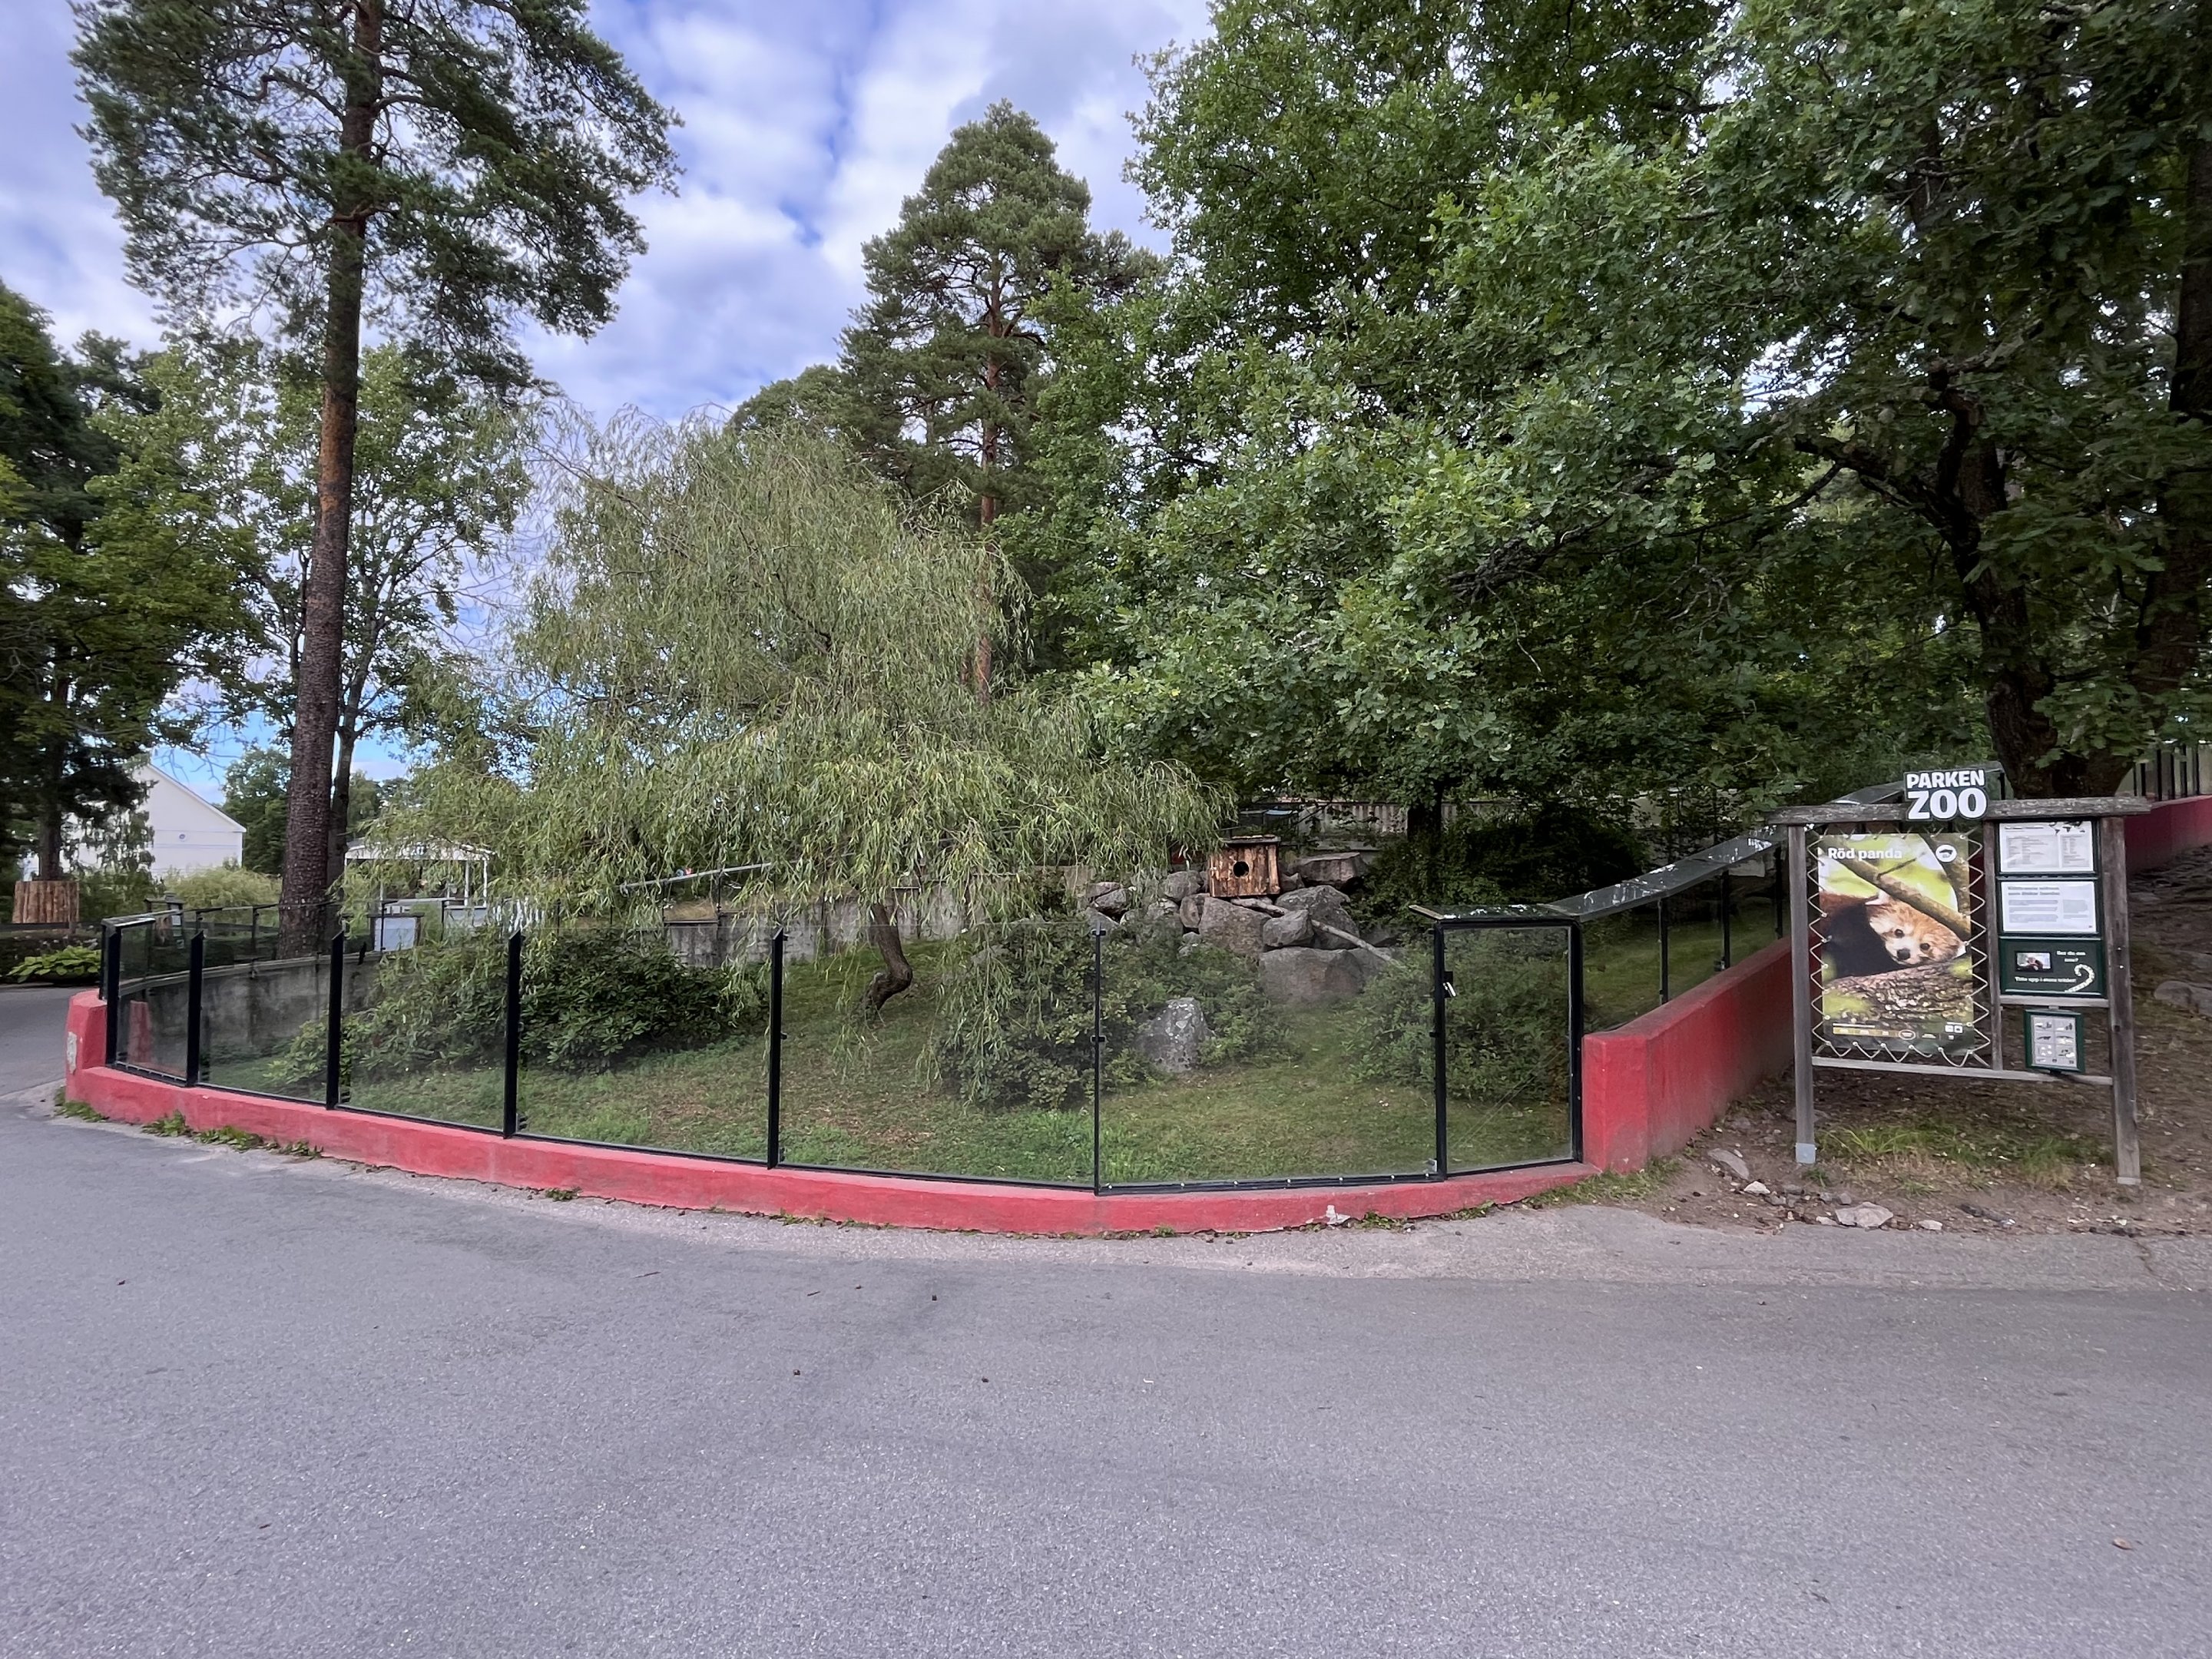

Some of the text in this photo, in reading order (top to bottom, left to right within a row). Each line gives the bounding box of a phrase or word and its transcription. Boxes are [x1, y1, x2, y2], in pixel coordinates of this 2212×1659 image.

[1906, 769, 1985, 789] PARKEN
[1908, 787, 1987, 820] ZOO
[1828, 847, 1902, 861] Röd panda
